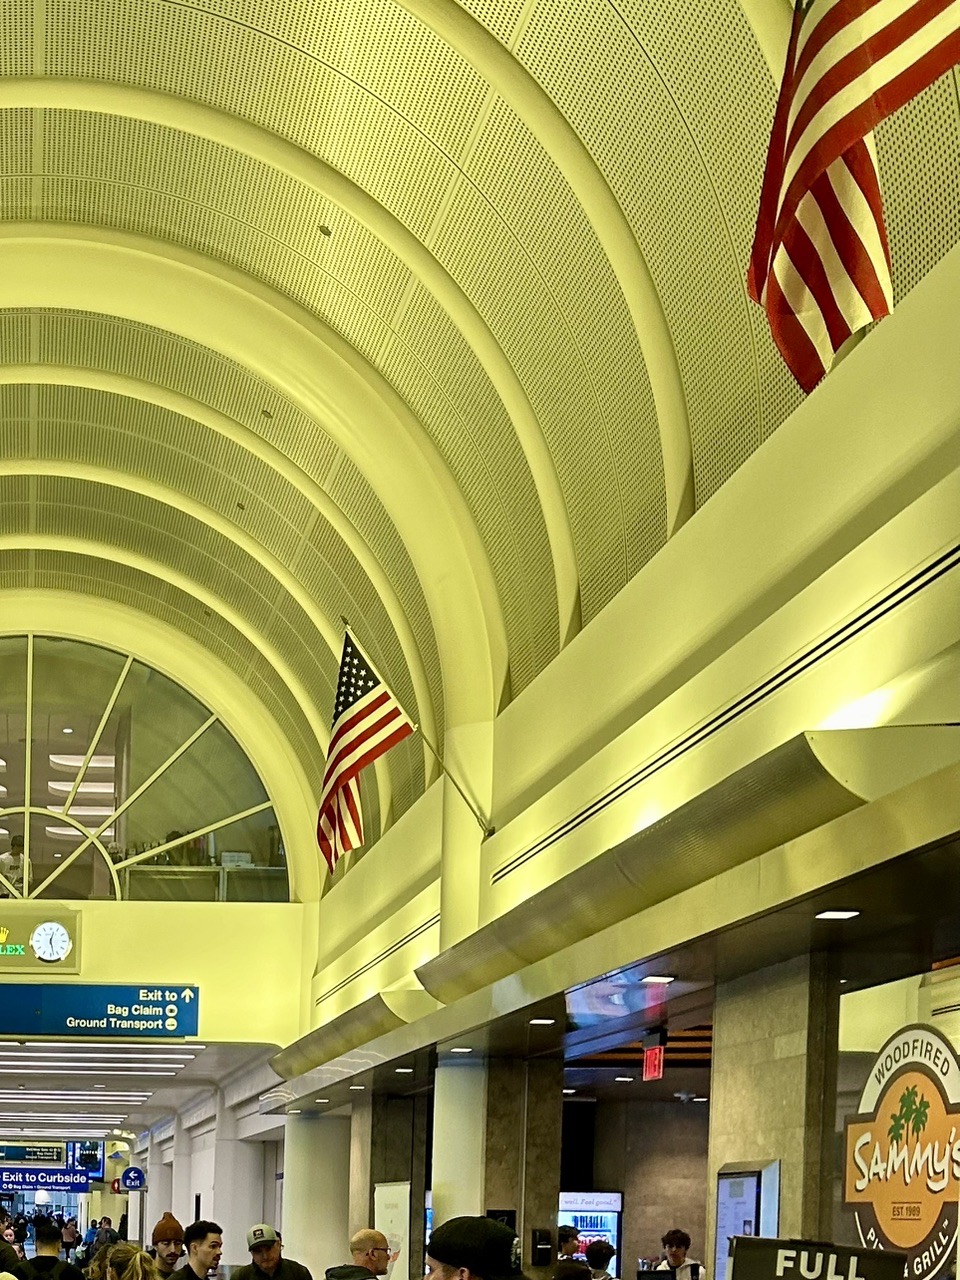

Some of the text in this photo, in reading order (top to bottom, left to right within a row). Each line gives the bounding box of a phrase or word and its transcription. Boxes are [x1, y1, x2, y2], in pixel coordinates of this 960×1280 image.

[139, 989, 178, 1001] Exit to
[107, 1004, 163, 1016] Bag Claim
[66, 1017, 162, 1031] Ground Transport
[874, 1038, 950, 1086] WOODFIRED
[2, 1172, 87, 1183] Exit to Curbside
[126, 1179, 140, 1187] Exit
[913, 1232, 948, 1275] GRILL
